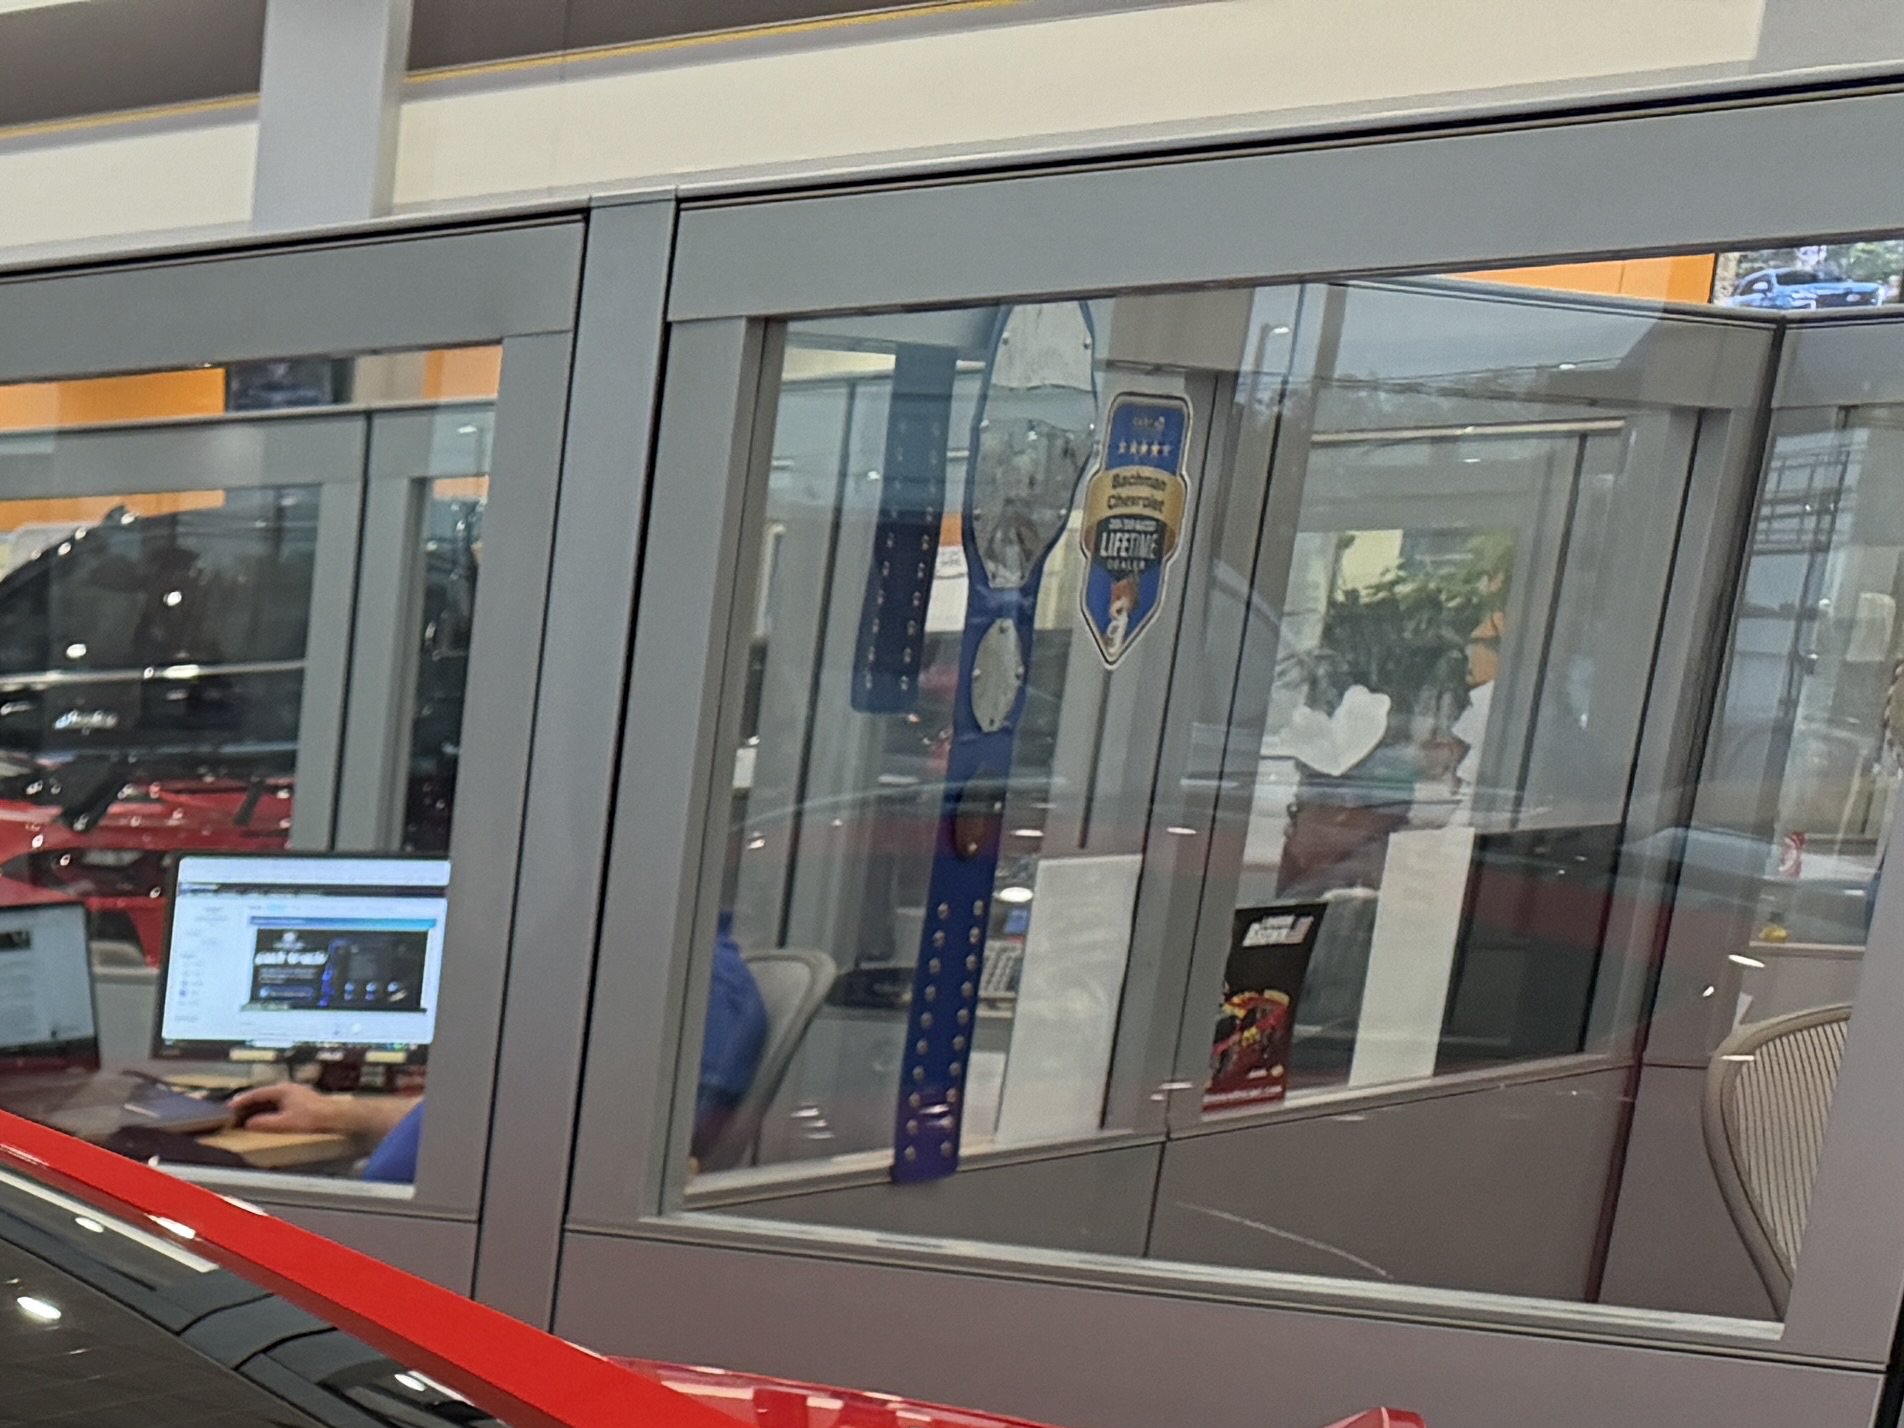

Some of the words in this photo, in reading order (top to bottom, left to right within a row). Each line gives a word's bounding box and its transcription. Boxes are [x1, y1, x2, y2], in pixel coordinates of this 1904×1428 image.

[1111, 472, 1167, 492] Bachman
[1107, 494, 1165, 514] Chevrolet
[1099, 532, 1158, 559] LIFETIME
